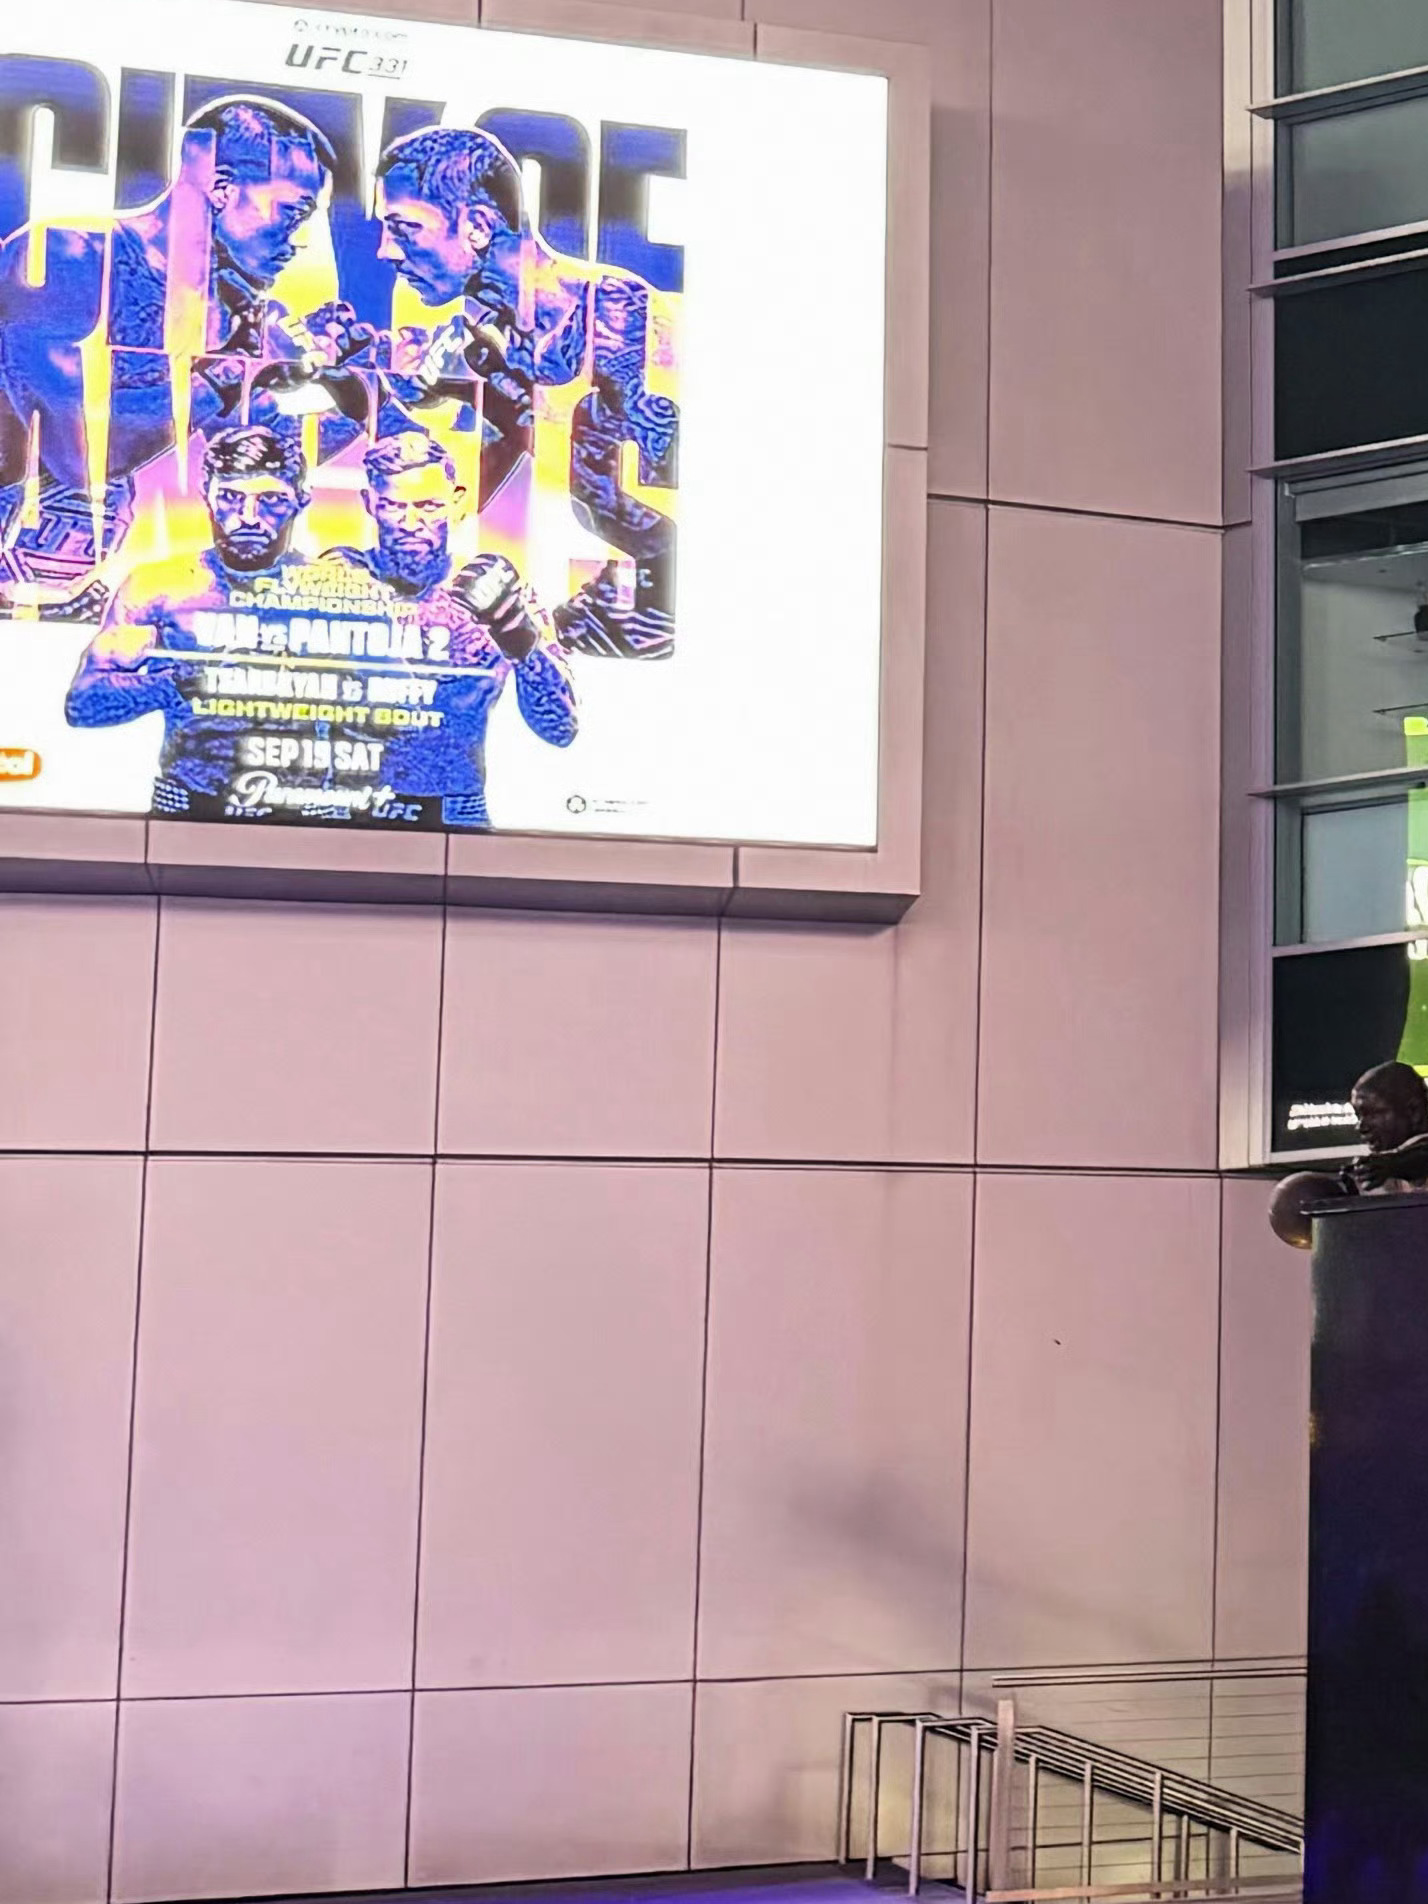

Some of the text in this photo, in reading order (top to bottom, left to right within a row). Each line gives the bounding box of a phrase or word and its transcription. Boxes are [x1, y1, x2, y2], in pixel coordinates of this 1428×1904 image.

[285, 43, 368, 75] UFC
[289, 617, 424, 660] PANTOJA
[427, 625, 450, 661] 2
[193, 697, 444, 727] LIGHTWEIGHT BOUT
[248, 736, 385, 772] SEP 19 SAT
